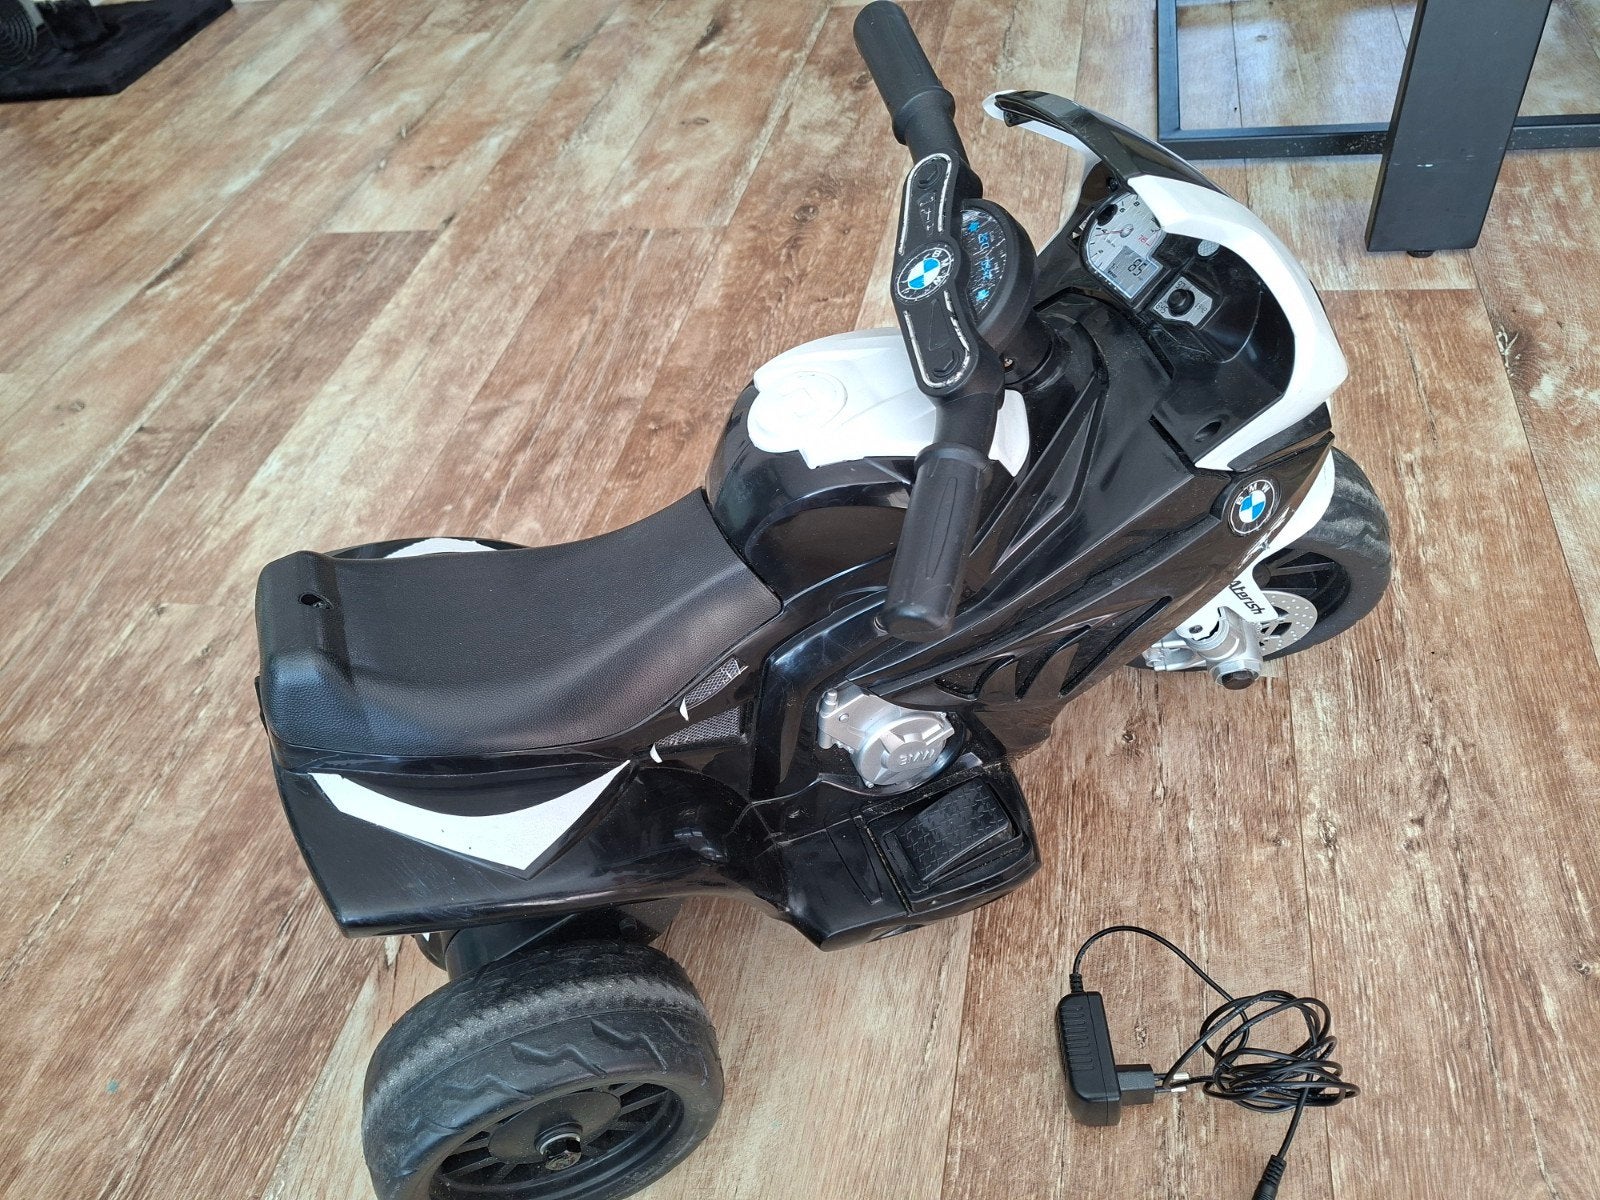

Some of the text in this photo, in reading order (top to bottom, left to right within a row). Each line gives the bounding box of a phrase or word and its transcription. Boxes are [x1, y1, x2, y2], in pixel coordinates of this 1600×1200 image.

[931, 249, 951, 286] BMW
[1127, 258, 1148, 276] 85
[1234, 481, 1271, 506] BMW
[899, 749, 936, 767] BMW
